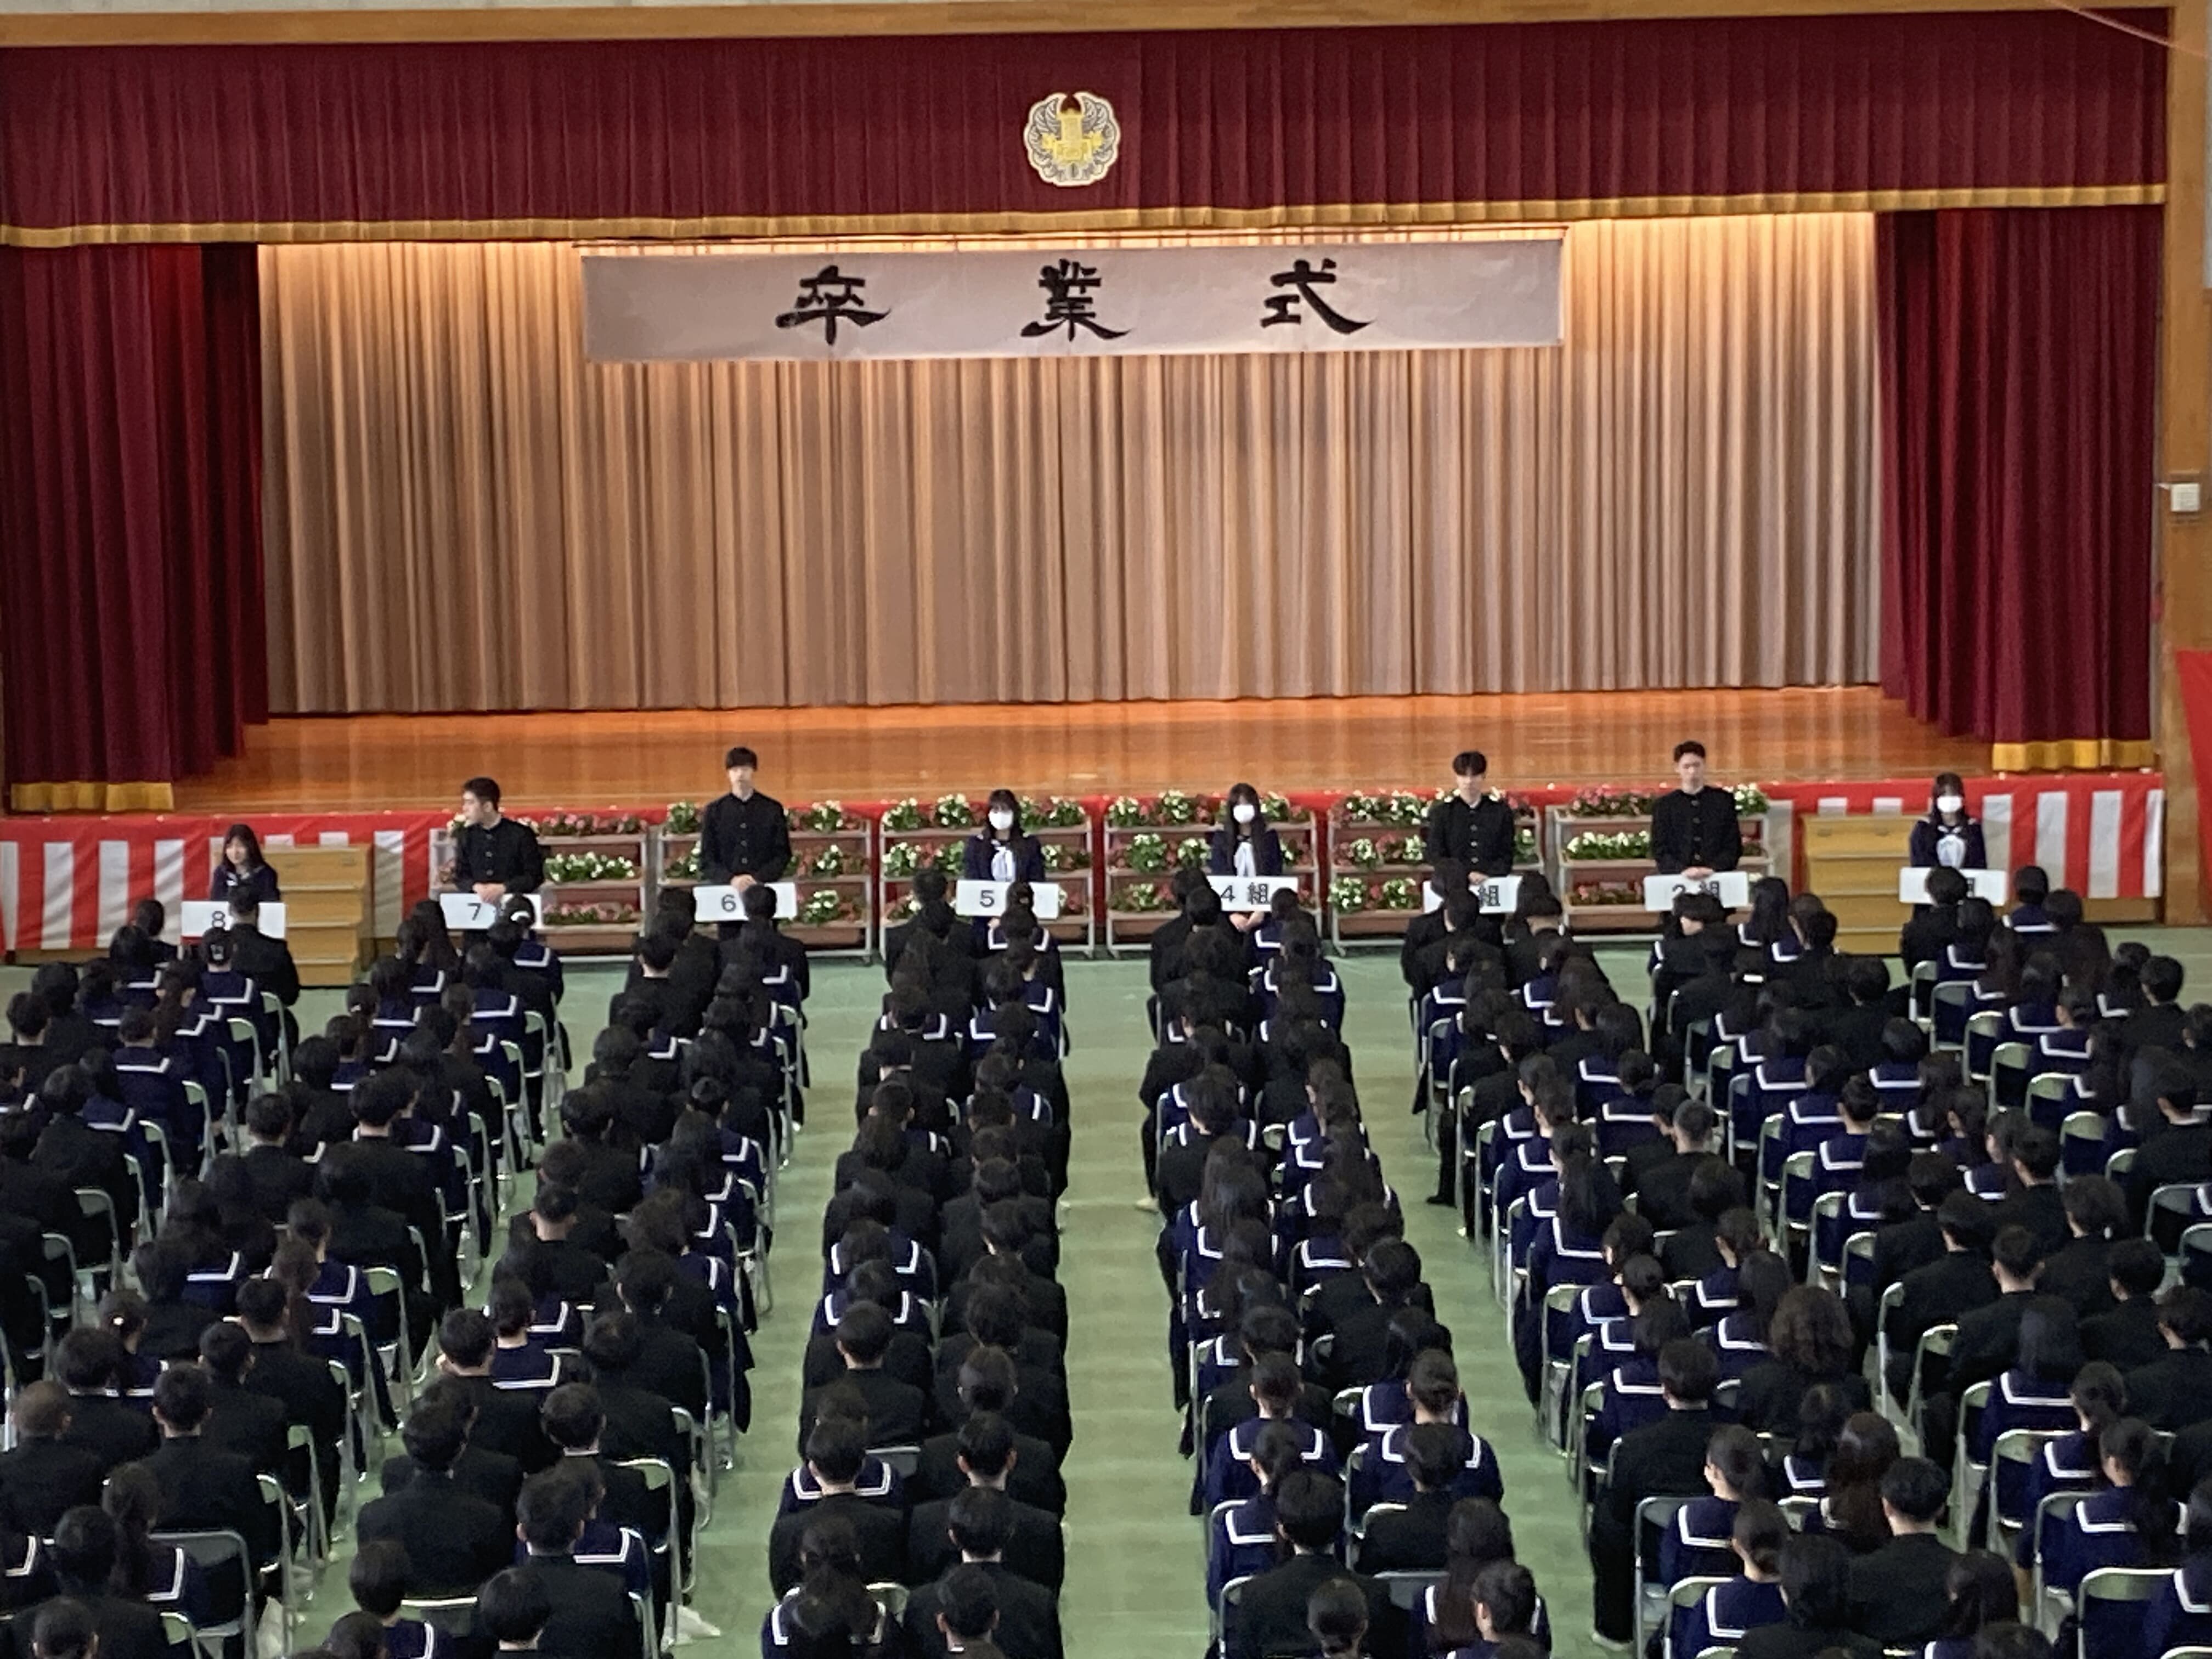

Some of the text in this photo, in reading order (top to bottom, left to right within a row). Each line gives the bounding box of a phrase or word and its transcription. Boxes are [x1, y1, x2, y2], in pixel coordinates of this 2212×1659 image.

[775, 258, 1373, 346] 卒業式
[721, 894, 736, 912] 6
[980, 889, 995, 907] 5
[212, 911, 225, 928] 8
[467, 903, 481, 921] 7
